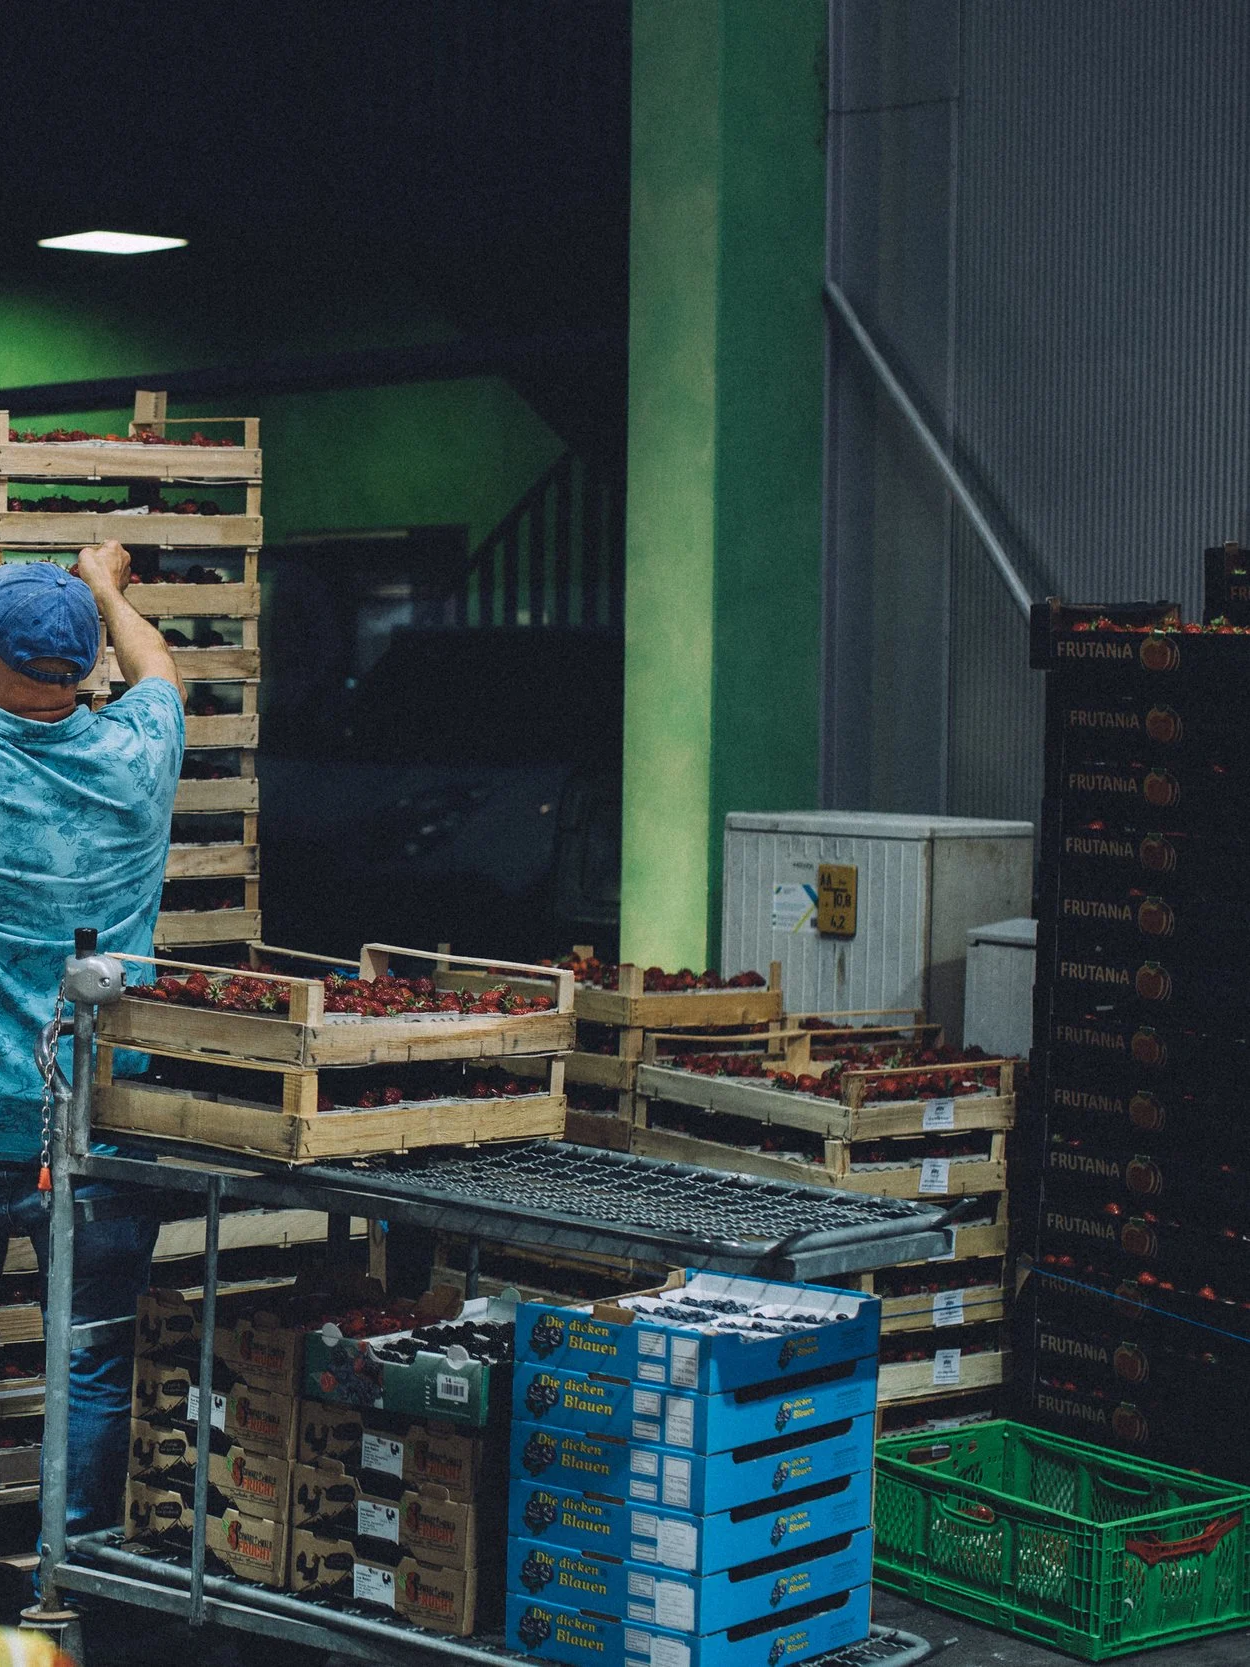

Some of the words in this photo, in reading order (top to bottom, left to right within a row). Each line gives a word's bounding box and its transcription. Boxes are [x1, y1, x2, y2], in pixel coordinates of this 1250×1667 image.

[546, 1316, 564, 1330] Die
[569, 1319, 609, 1337] dicken
[569, 1335, 617, 1356] Blauen
[540, 1375, 560, 1390] Die
[564, 1379, 605, 1396] dicken
[564, 1394, 613, 1416] Blauen
[537, 1433, 557, 1449] Die
[561, 1438, 602, 1456] dicken
[561, 1453, 609, 1475] Blauen
[243, 1478, 276, 1497] FRUCHT
[538, 1492, 558, 1508] Die
[562, 1497, 602, 1515] dicken
[562, 1512, 611, 1534] Blauen
[238, 1540, 270, 1560] FRUCHT
[535, 1551, 554, 1567] Die
[558, 1557, 599, 1575] dicken
[558, 1572, 607, 1595] Blauen
[418, 1594, 454, 1613] FRUCHT
[532, 1607, 552, 1624] Die
[556, 1613, 596, 1632] dicken
[556, 1628, 604, 1651] Blauen
